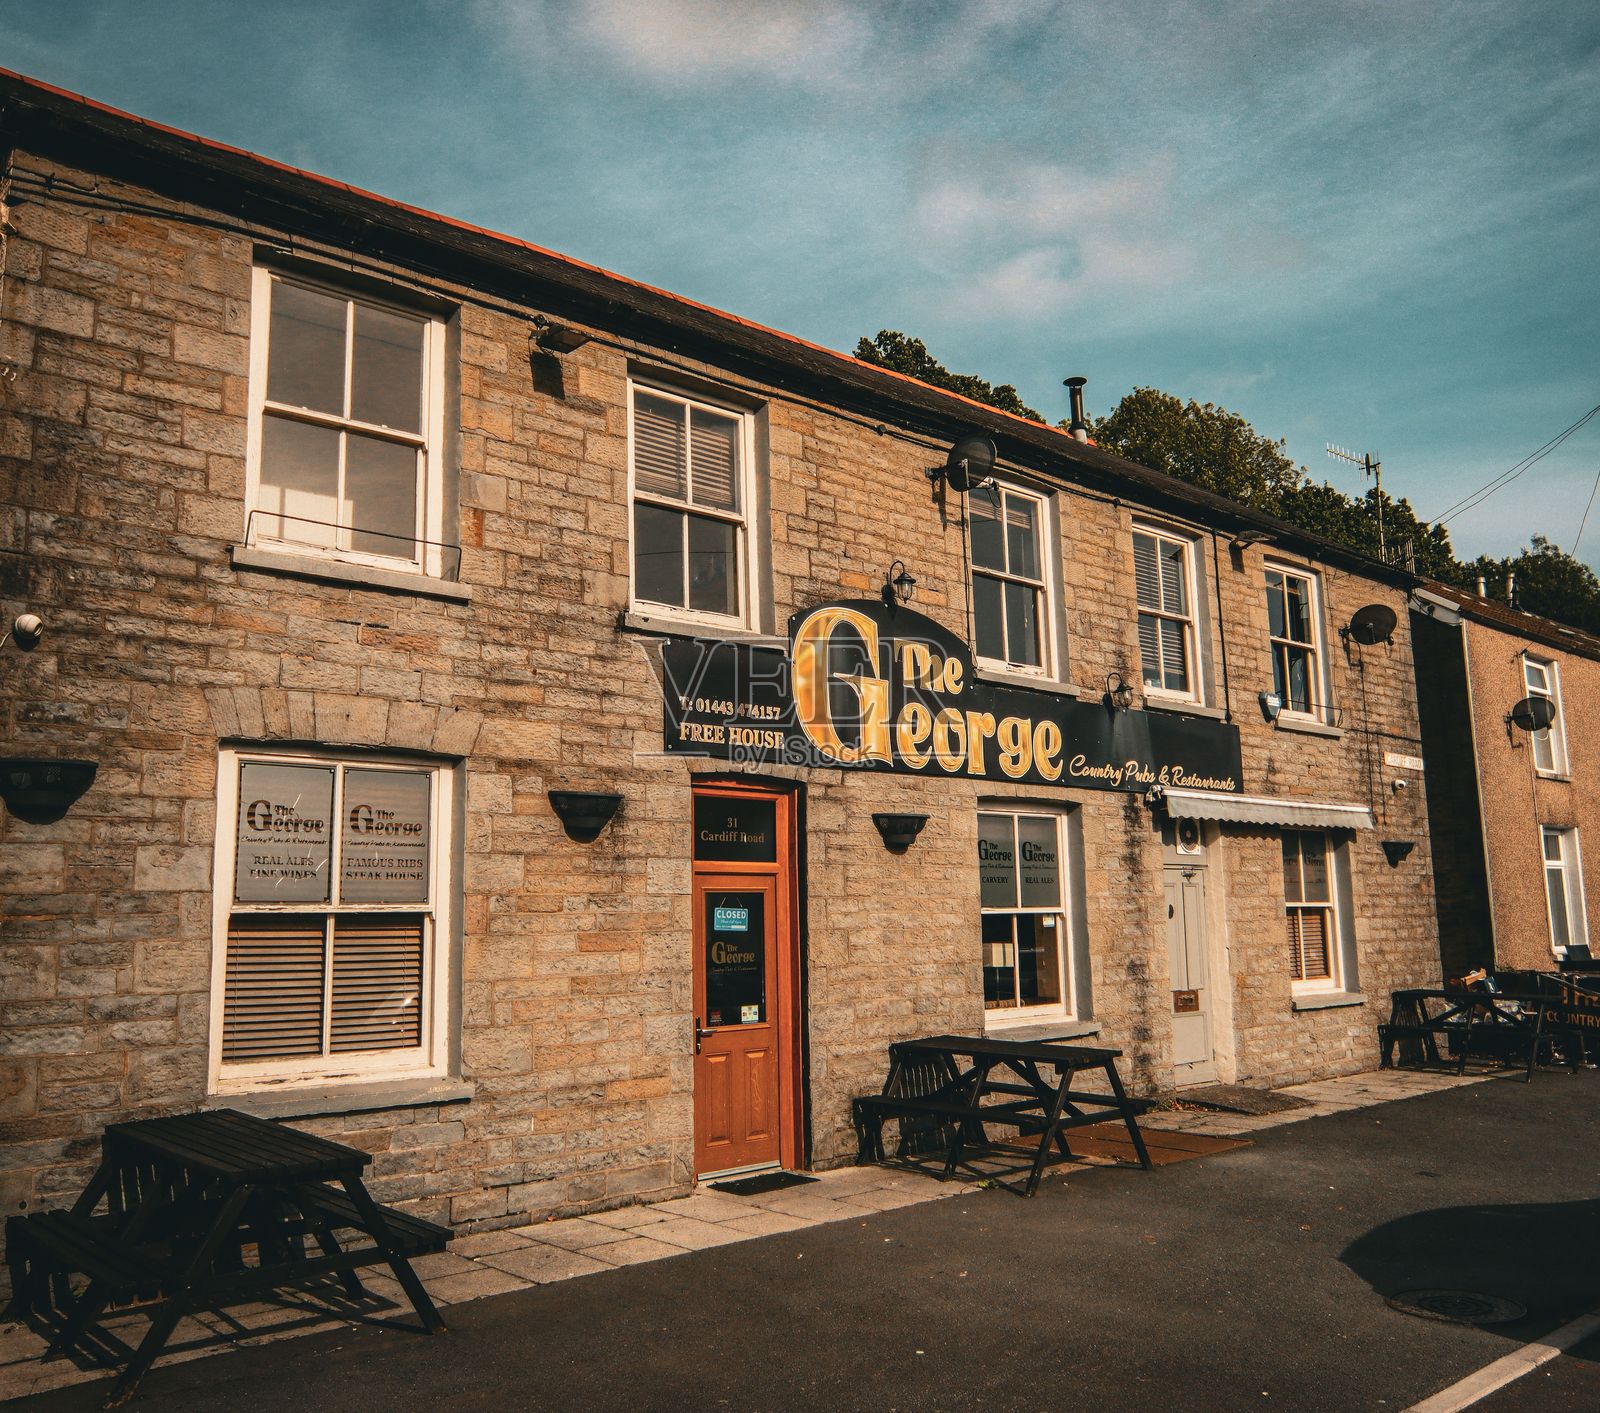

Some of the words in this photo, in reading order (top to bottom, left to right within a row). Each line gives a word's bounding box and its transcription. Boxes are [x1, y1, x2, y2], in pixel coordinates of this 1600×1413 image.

[895, 638, 963, 695] The
[792, 606, 1063, 780] George
[695, 698, 735, 716] 01443
[736, 703, 781, 720] 474157
[680, 721, 726, 744] FREE
[729, 727, 785, 749] HOUSE
[1069, 754, 1123, 787] Country
[1125, 760, 1156, 783] Pubs
[1158, 765, 1169, 784] &
[1171, 766, 1236, 791] Restaurants
[275, 804, 295, 816] The
[376, 809, 395, 820] The
[247, 799, 325, 834] George
[349, 804, 423, 837] George
[727, 817, 738, 828] 31
[700, 830, 738, 842] Cardiff
[740, 831, 765, 843] Road
[977, 839, 1012, 862] George
[989, 842, 998, 850] The
[1022, 841, 1055, 862] George
[254, 856, 283, 866] REAL
[286, 856, 315, 866] ALES
[346, 858, 394, 868] FAMOUS
[397, 859, 423, 868] RIBS
[250, 869, 278, 878] FINE
[280, 870, 318, 879] WINES
[345, 871, 383, 880] STEAK
[386, 872, 424, 880] HOUSE
[982, 876, 1009, 884] CARVERY
[1025, 876, 1039, 884] REAL
[716, 909, 747, 919] CLOSED
[711, 941, 756, 965] George
